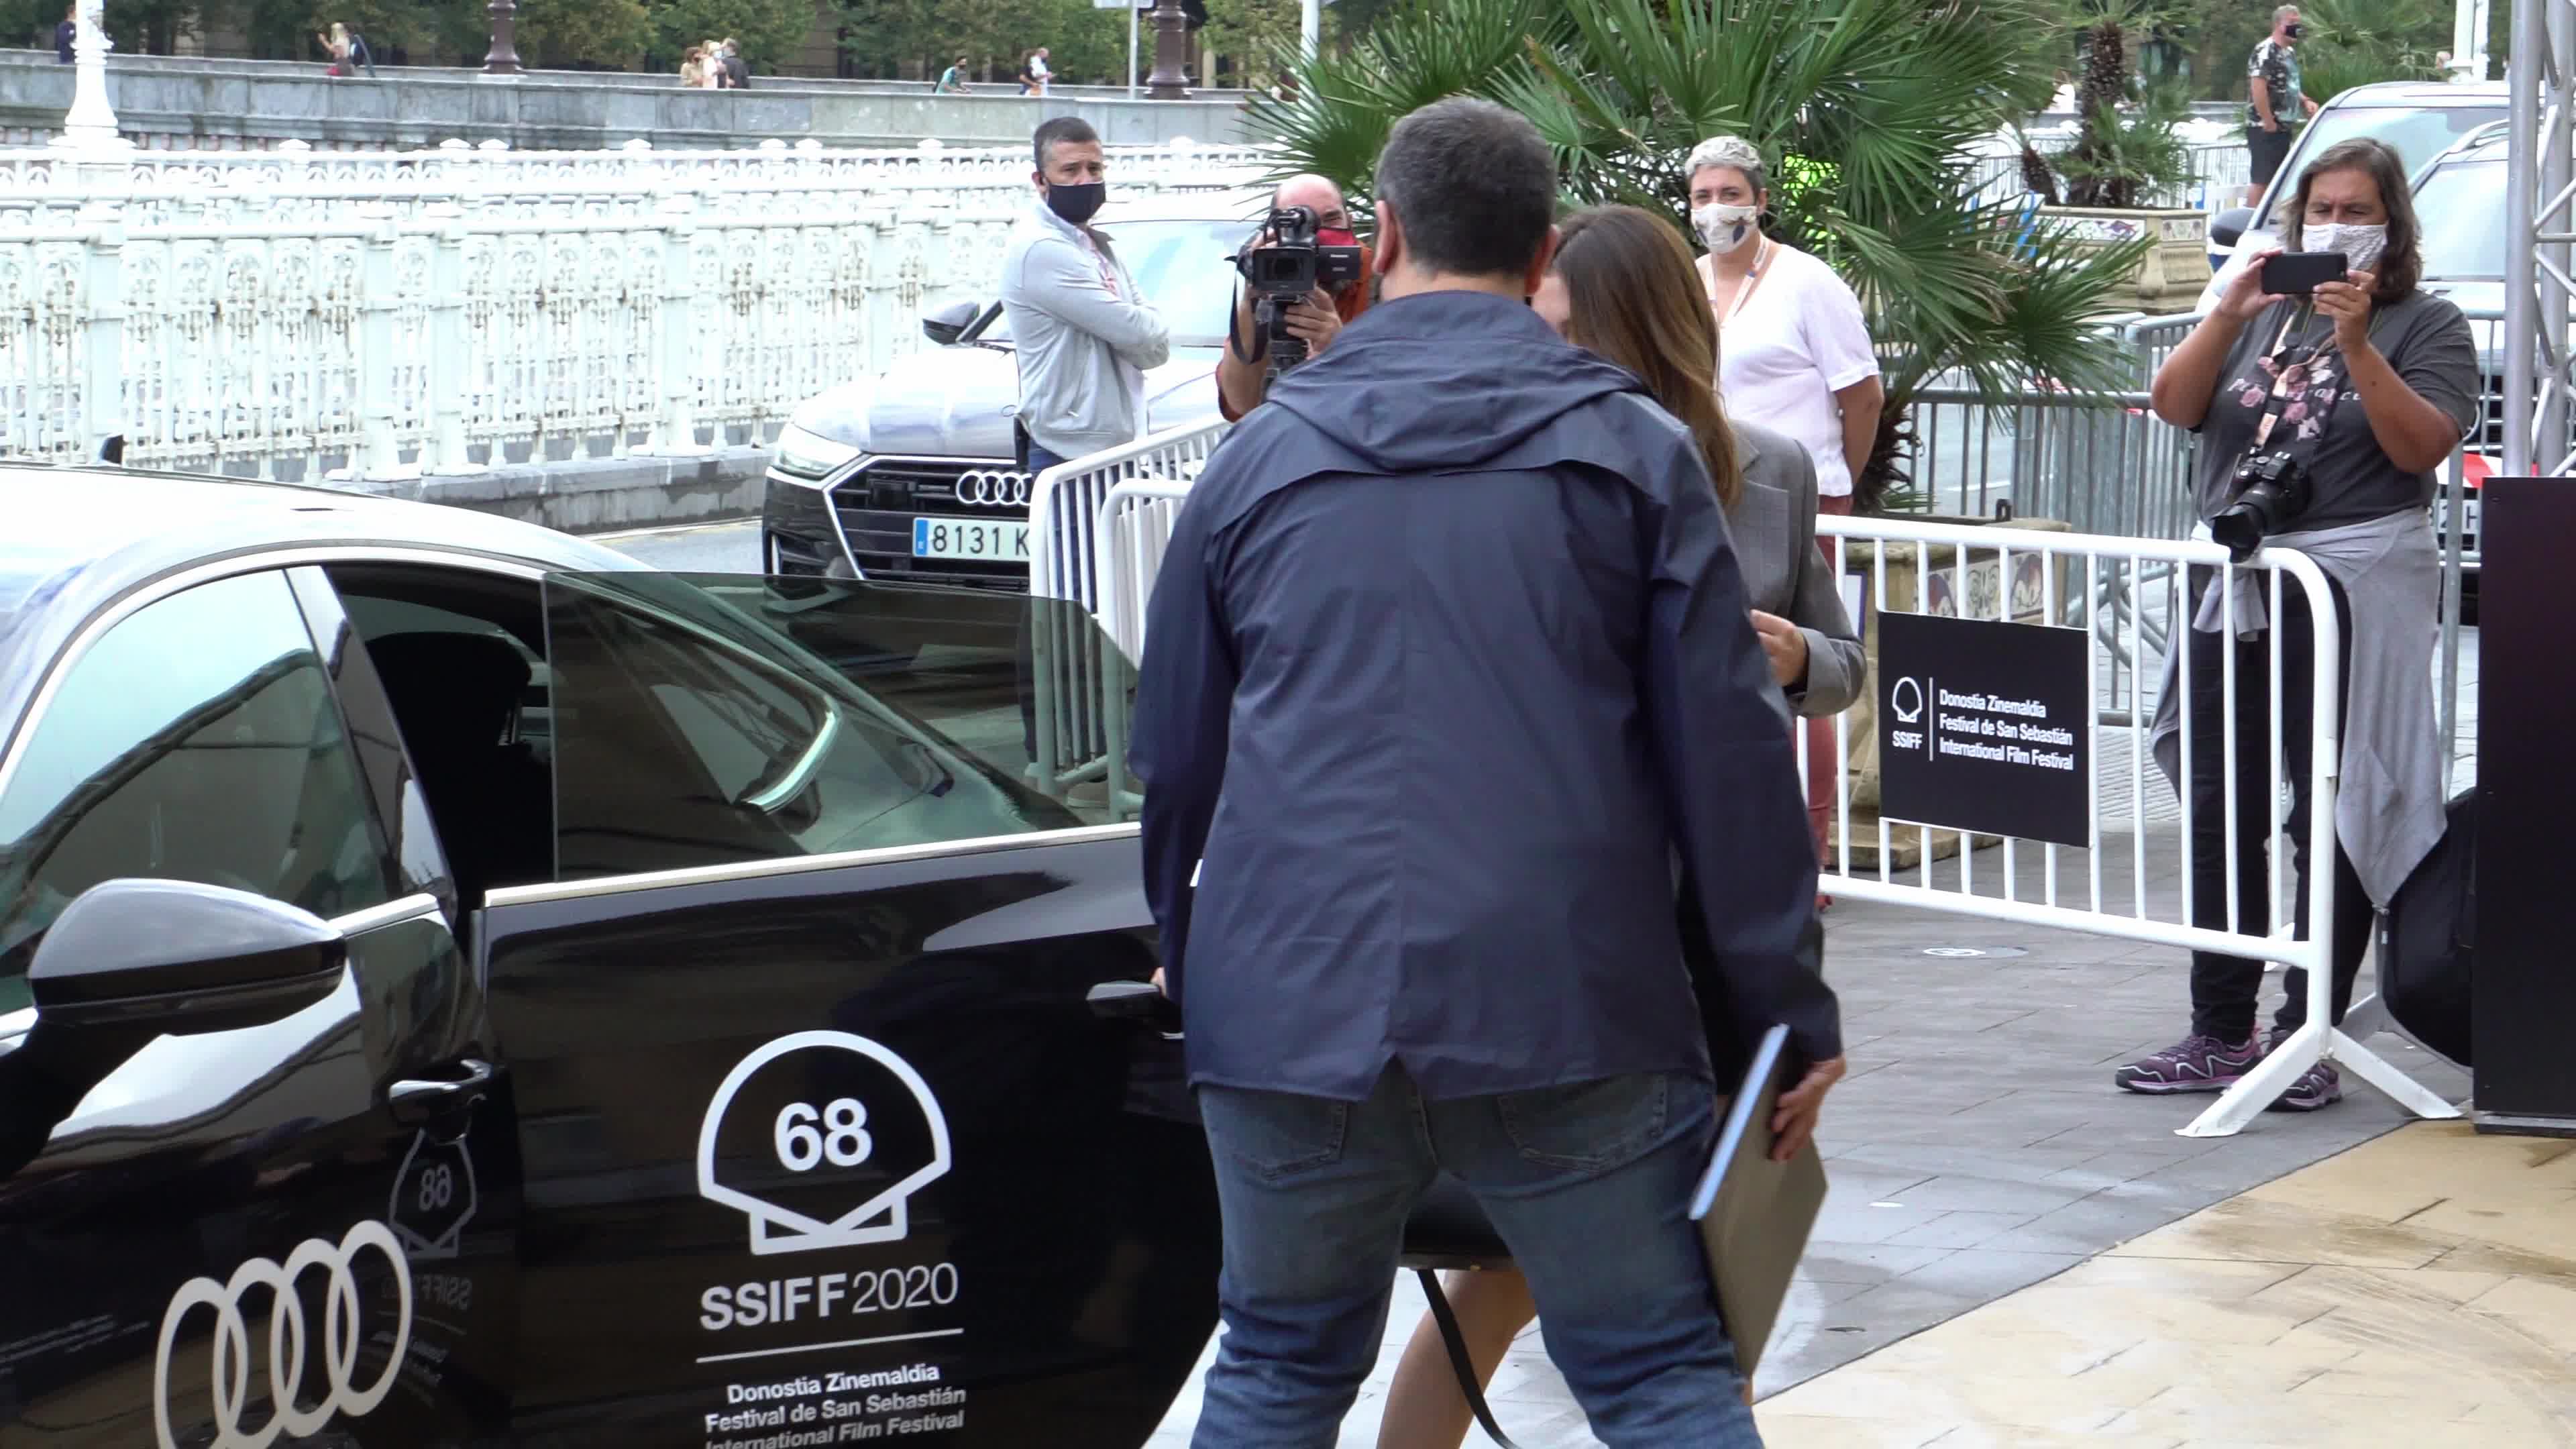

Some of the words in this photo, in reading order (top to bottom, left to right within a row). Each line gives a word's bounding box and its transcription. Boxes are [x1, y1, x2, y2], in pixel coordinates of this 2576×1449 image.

[932, 525, 1000, 554] 8131
[1939, 689, 1986, 710] Donostia
[1987, 695, 2047, 718] Zinemaldia
[1892, 731, 1923, 749] SSIFF
[1939, 713, 1980, 734] Festival
[1981, 719, 1995, 736] de
[1996, 720, 2018, 739] San
[2019, 723, 2074, 746] Sebastián
[1939, 737, 2004, 761] International
[2006, 745, 2030, 764] Film
[2031, 749, 2074, 771] Festival
[774, 1097, 873, 1172] 68
[700, 1273, 848, 1331] SSIFF
[852, 1263, 959, 1314] 2020
[727, 1376, 822, 1404] Donostia
[824, 1362, 941, 1393] Zinemaldia
[704, 1405, 786, 1434] Festival
[790, 1403, 816, 1423] de
[821, 1399, 861, 1419] San
[865, 1386, 967, 1413] Sebastián
[839, 1421, 882, 1441] Film
[886, 1409, 965, 1436] Festival
